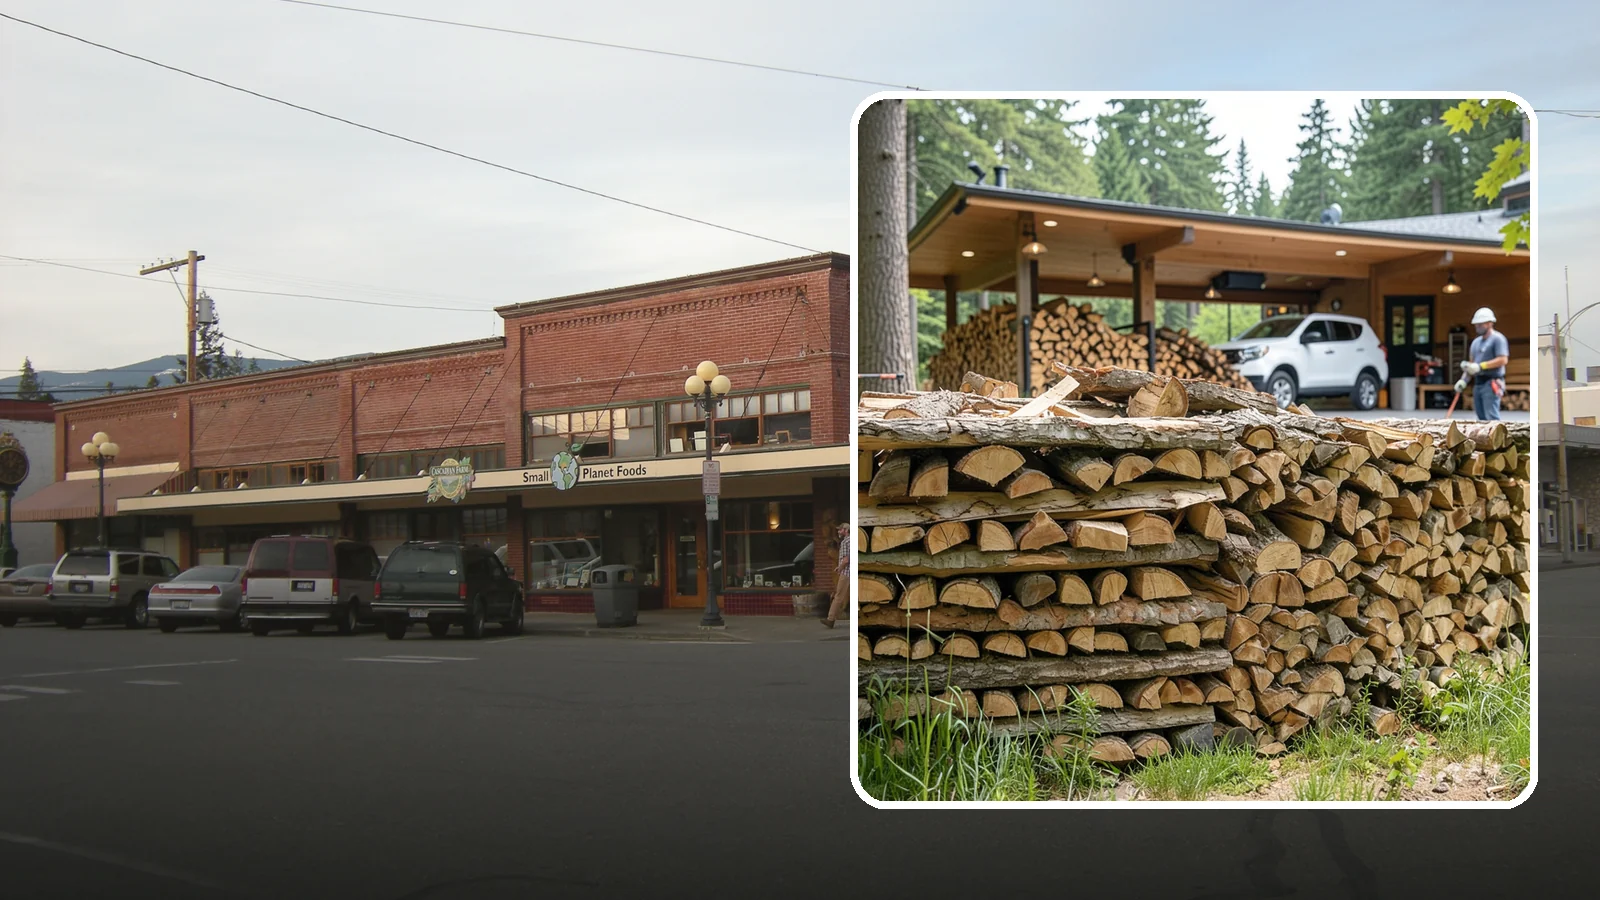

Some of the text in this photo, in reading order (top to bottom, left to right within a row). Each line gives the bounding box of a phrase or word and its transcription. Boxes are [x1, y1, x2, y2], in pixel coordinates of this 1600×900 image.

[523, 464, 647, 483] Small Planet Foods
